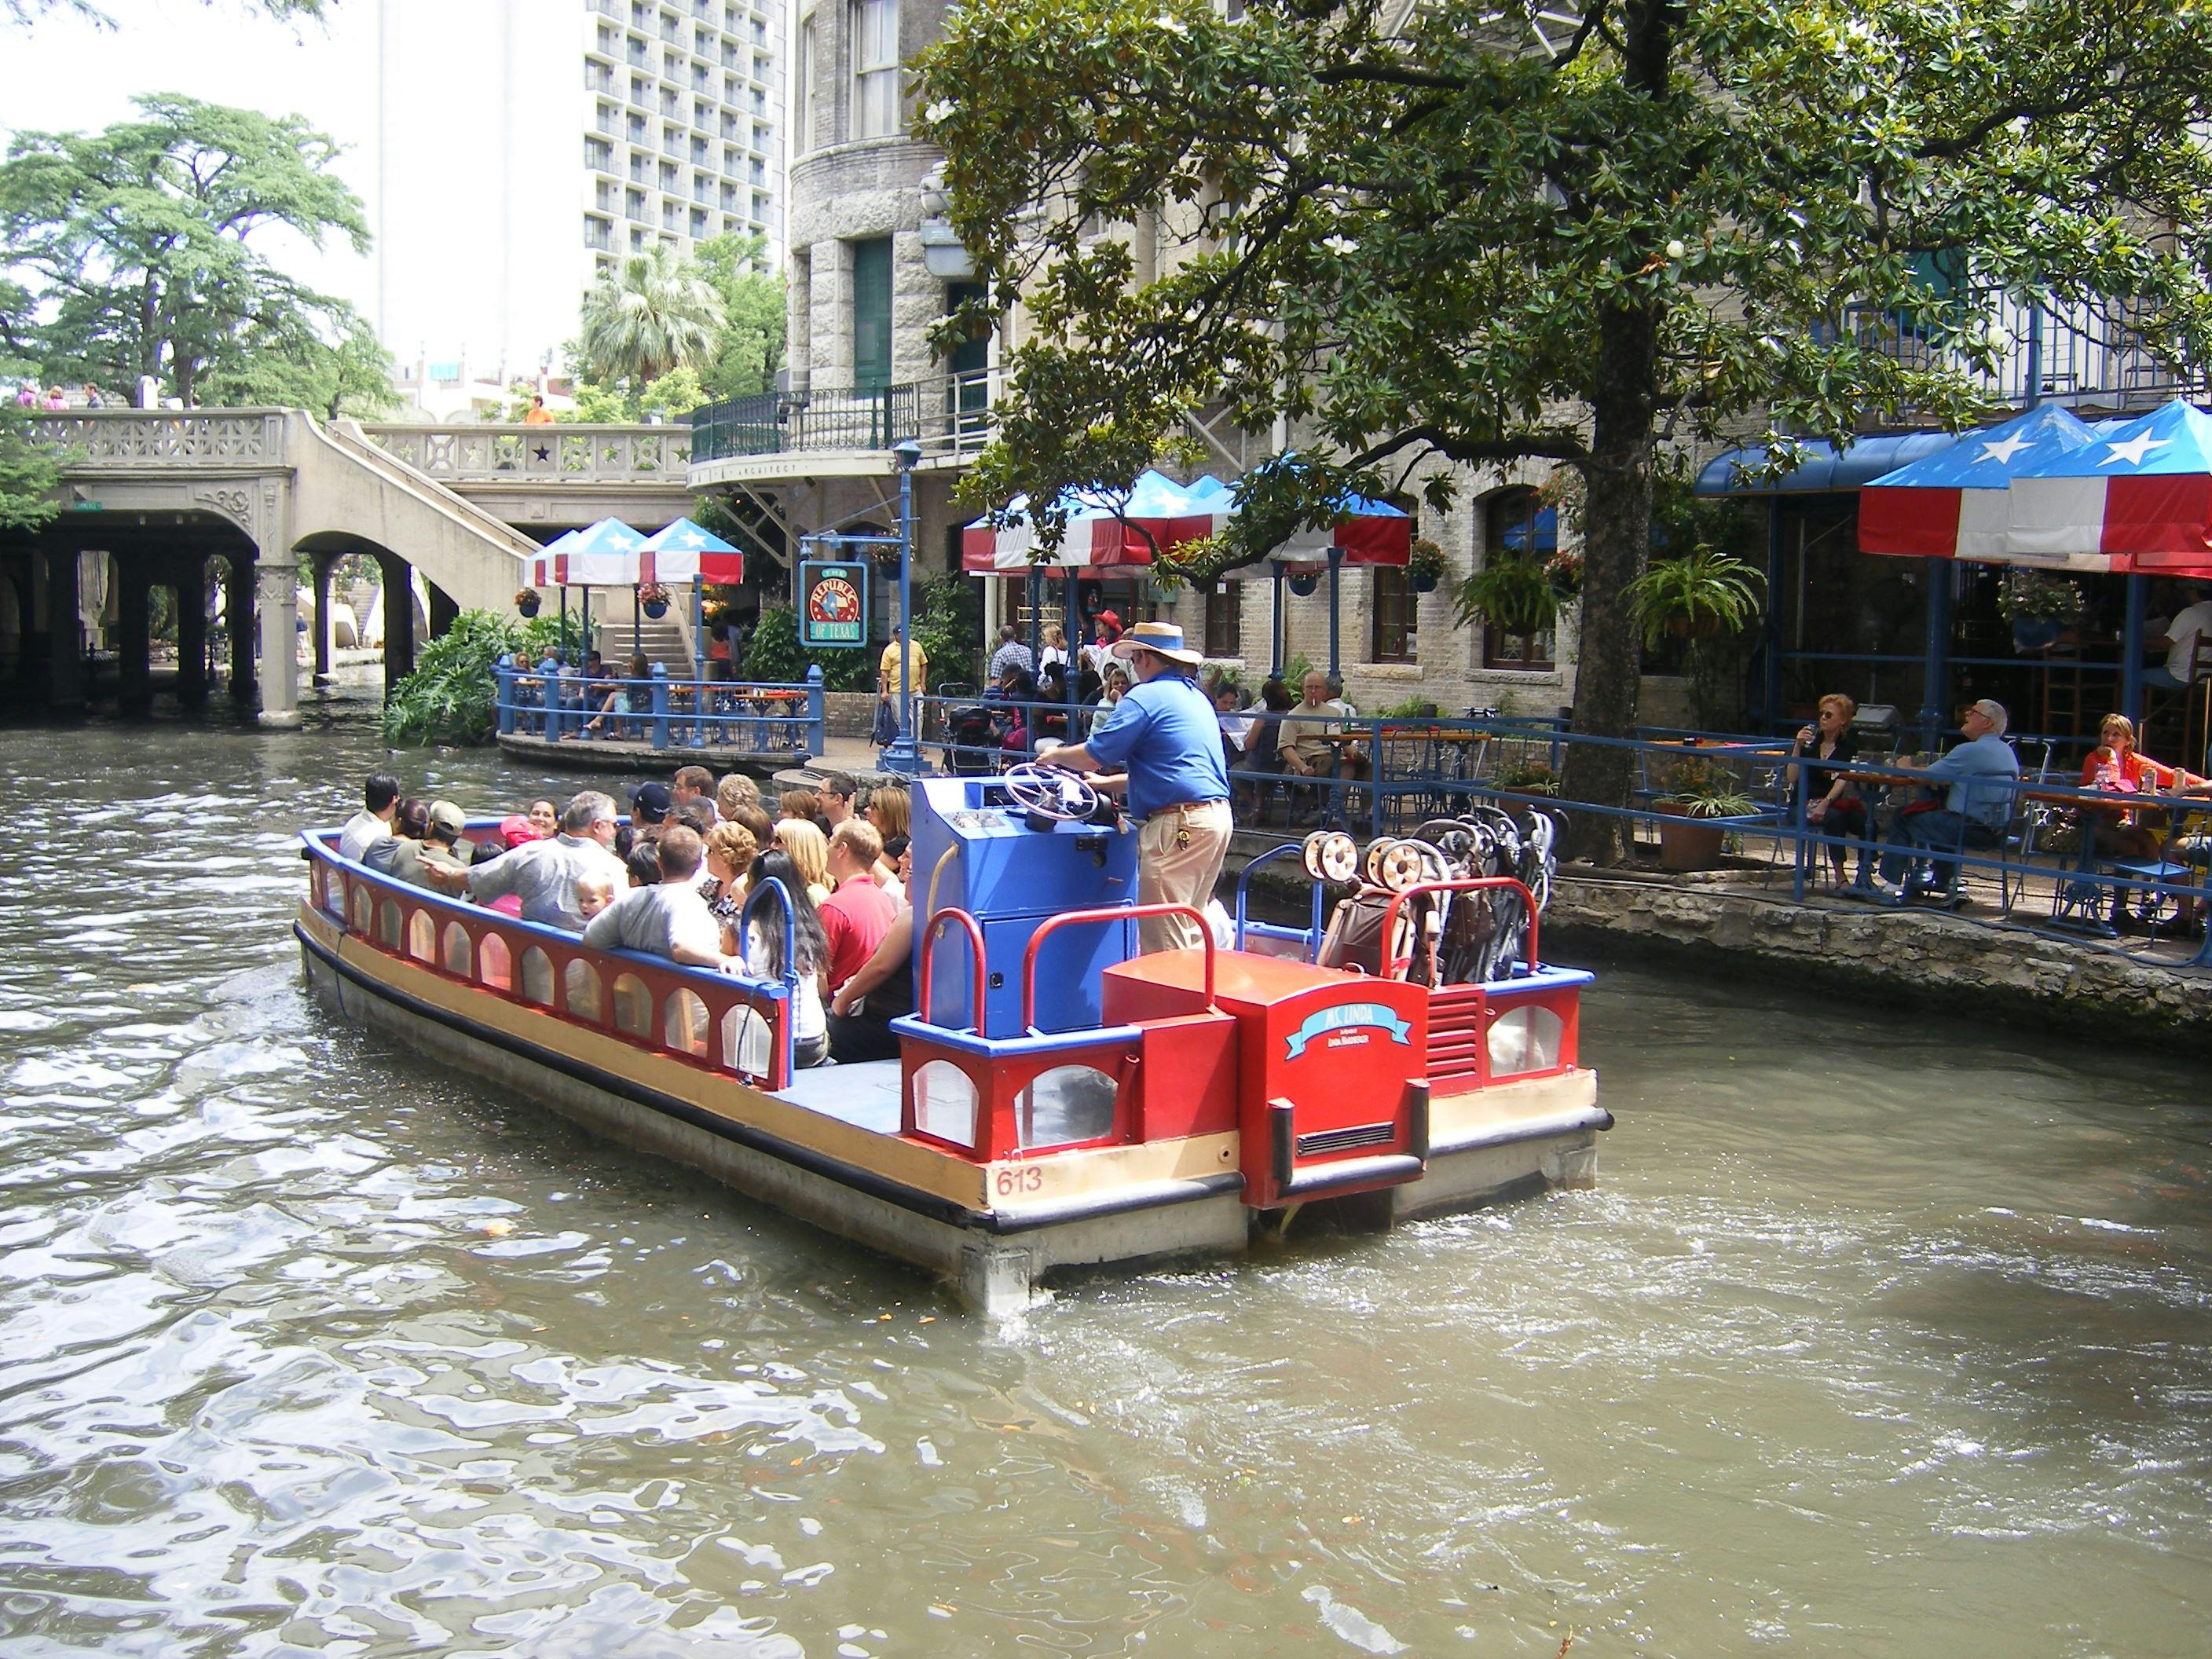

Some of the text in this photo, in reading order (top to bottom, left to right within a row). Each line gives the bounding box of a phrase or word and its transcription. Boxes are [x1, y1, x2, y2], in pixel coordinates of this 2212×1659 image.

[812, 580, 856, 603] REPUBLIC
[815, 623, 855, 639] OF TEXAS
[1344, 1004, 1374, 1024] LINDA
[997, 1166, 1042, 1196] 613
